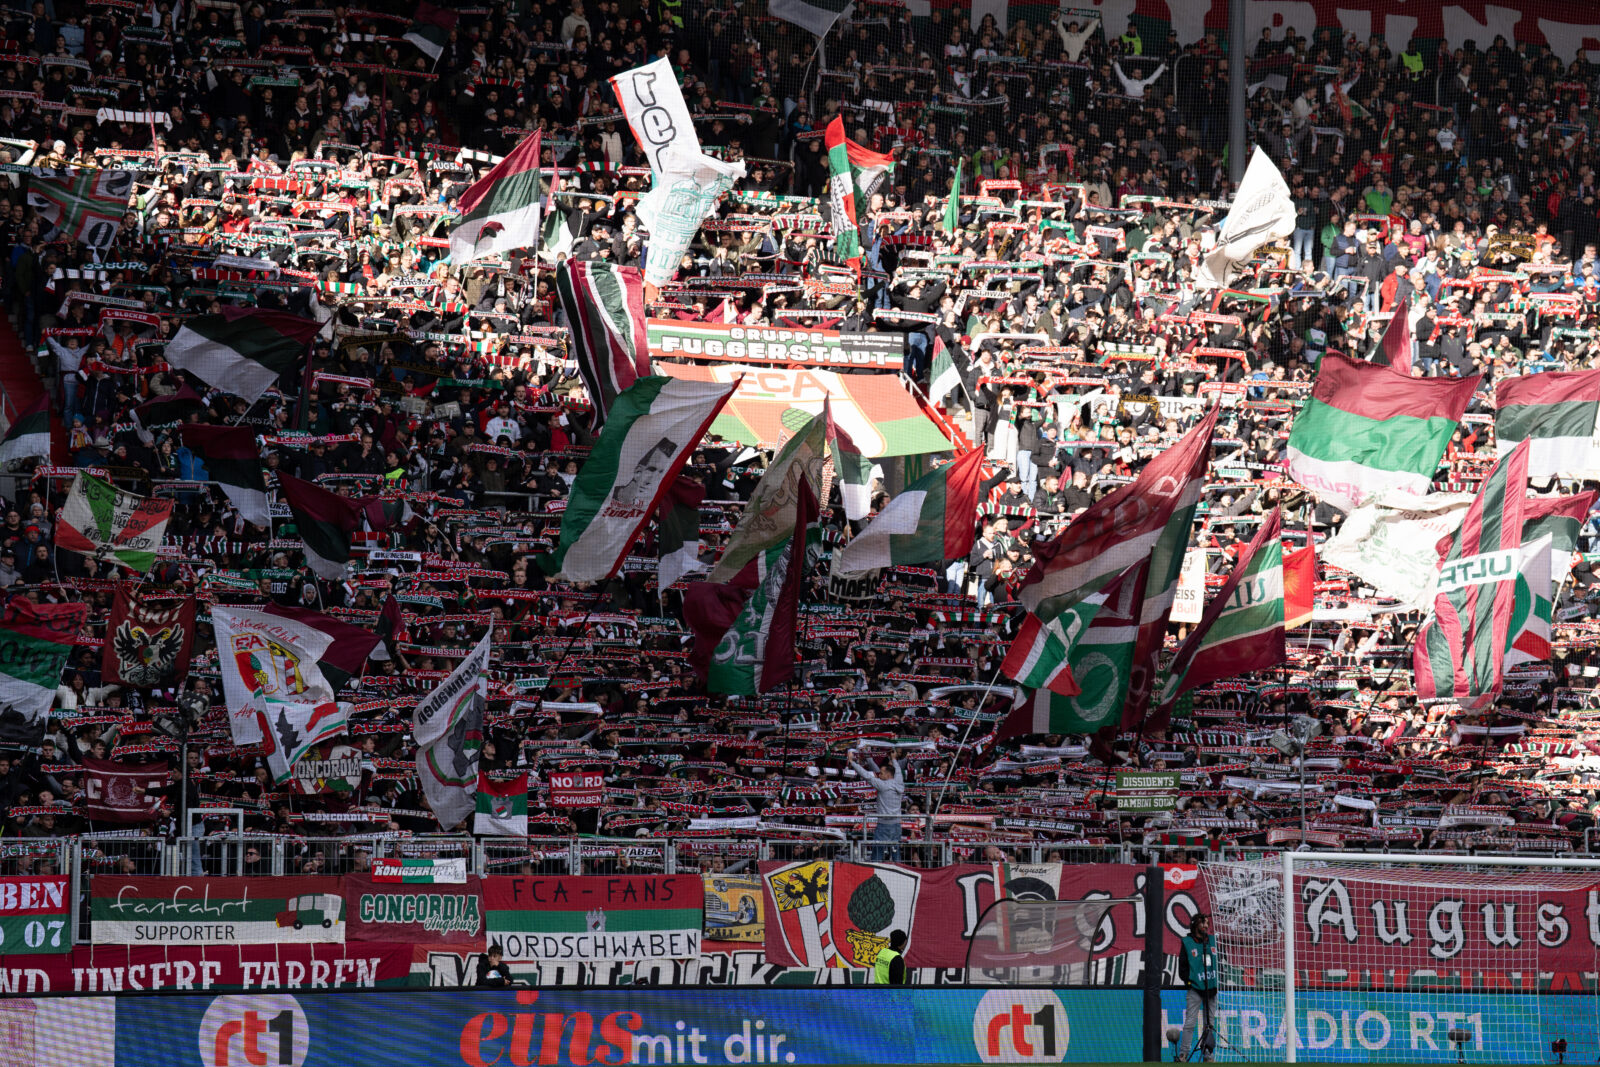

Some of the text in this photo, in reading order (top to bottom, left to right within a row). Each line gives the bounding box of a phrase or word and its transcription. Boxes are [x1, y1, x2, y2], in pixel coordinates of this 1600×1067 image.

[106, 311, 148, 320] L-BLOCKER
[428, 333, 445, 341] DER
[731, 327, 824, 343] GRUPPE
[662, 336, 889, 365] FUGGERSTADT
[732, 371, 833, 398] FCA
[491, 590, 538, 601] AUGSBURG
[832, 575, 878, 598] MAFIA
[123, 724, 134, 734] FC
[1123, 777, 1174, 787] DISSIDENTS
[553, 795, 601, 806] SCHWABEN
[1118, 799, 1151, 807] BAMBINI
[310, 812, 369, 822] CONCORDIA
[1011, 865, 1047, 874] Augusta
[110, 884, 252, 916] fanfahrt
[513, 879, 568, 902] FCA
[608, 879, 675, 902] FANS
[360, 894, 480, 923] CONCORDIA
[25, 920, 65, 947] 07
[135, 925, 235, 940] SUPPORTER
[424, 915, 480, 936] Augsburg
[490, 929, 697, 959] NORDSCHWABEN
[215, 1009, 293, 1067] rt1
[460, 990, 797, 1067] eins mit dir.
[987, 1003, 1057, 1057] rt1
[1409, 1011, 1484, 1051] RT1
